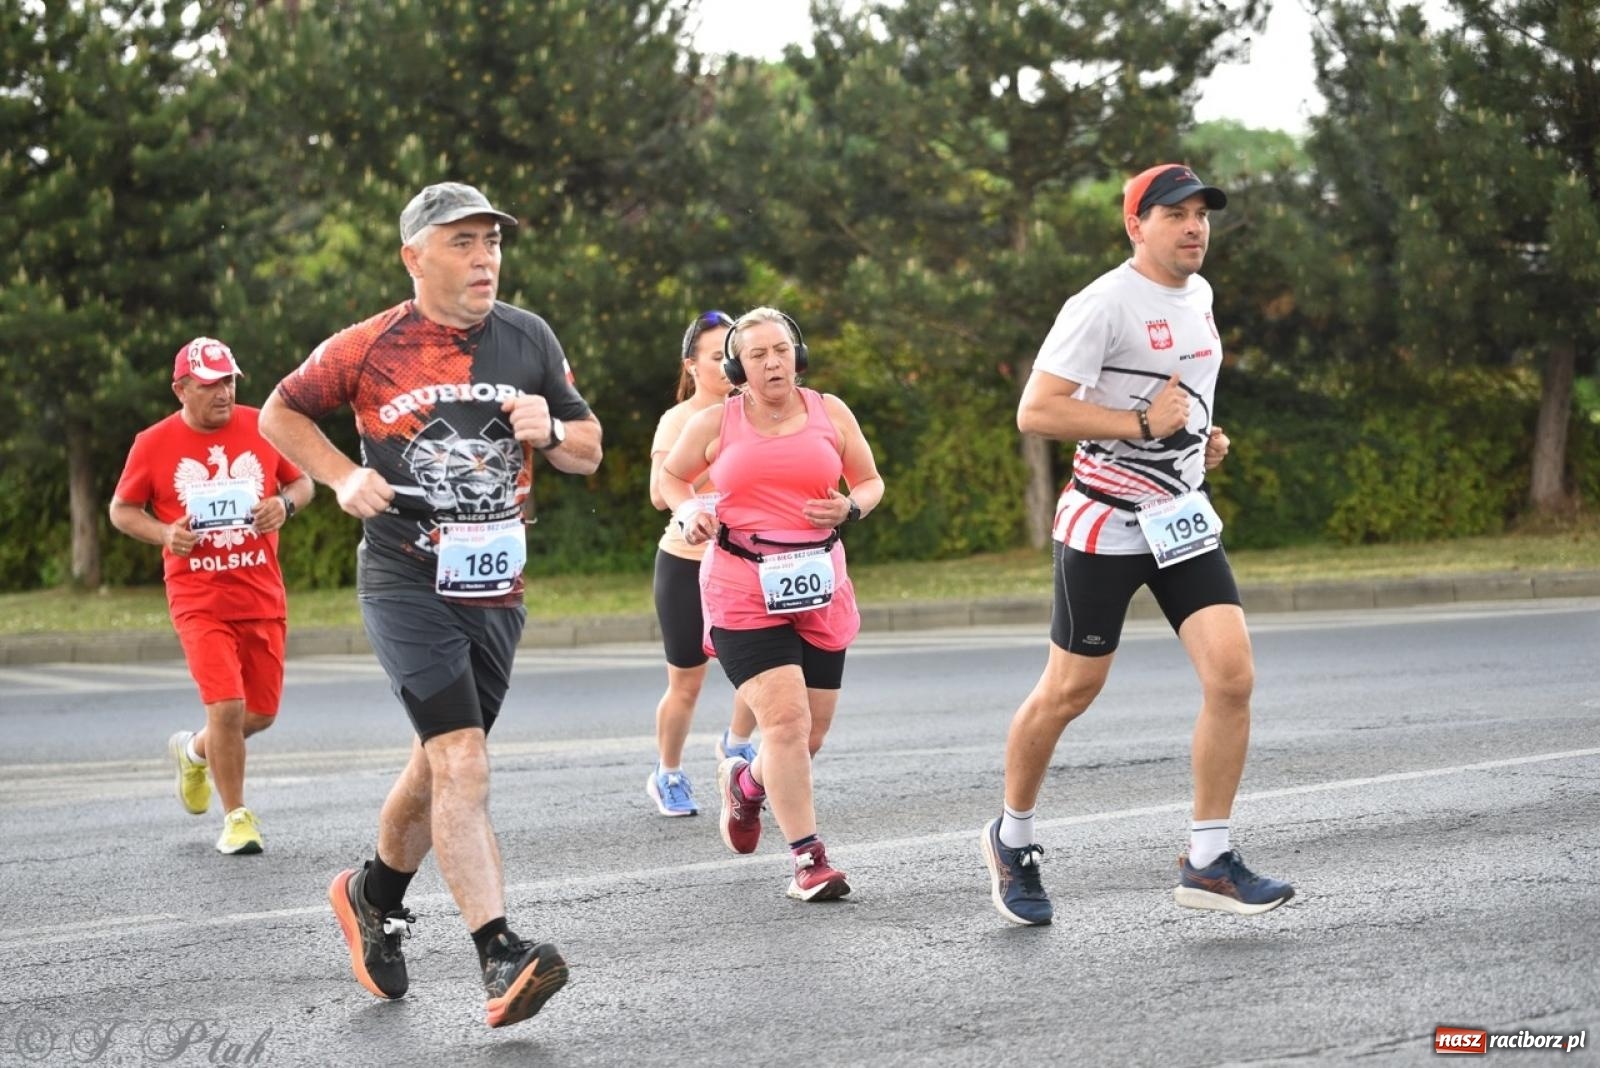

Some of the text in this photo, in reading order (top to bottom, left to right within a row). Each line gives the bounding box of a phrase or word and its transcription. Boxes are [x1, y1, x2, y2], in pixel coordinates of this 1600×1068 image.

[209, 500, 237, 517] 171
[1165, 512, 1209, 543] 198
[189, 549, 267, 572] POLSKA
[465, 551, 509, 577] 186
[780, 573, 821, 596] 260
